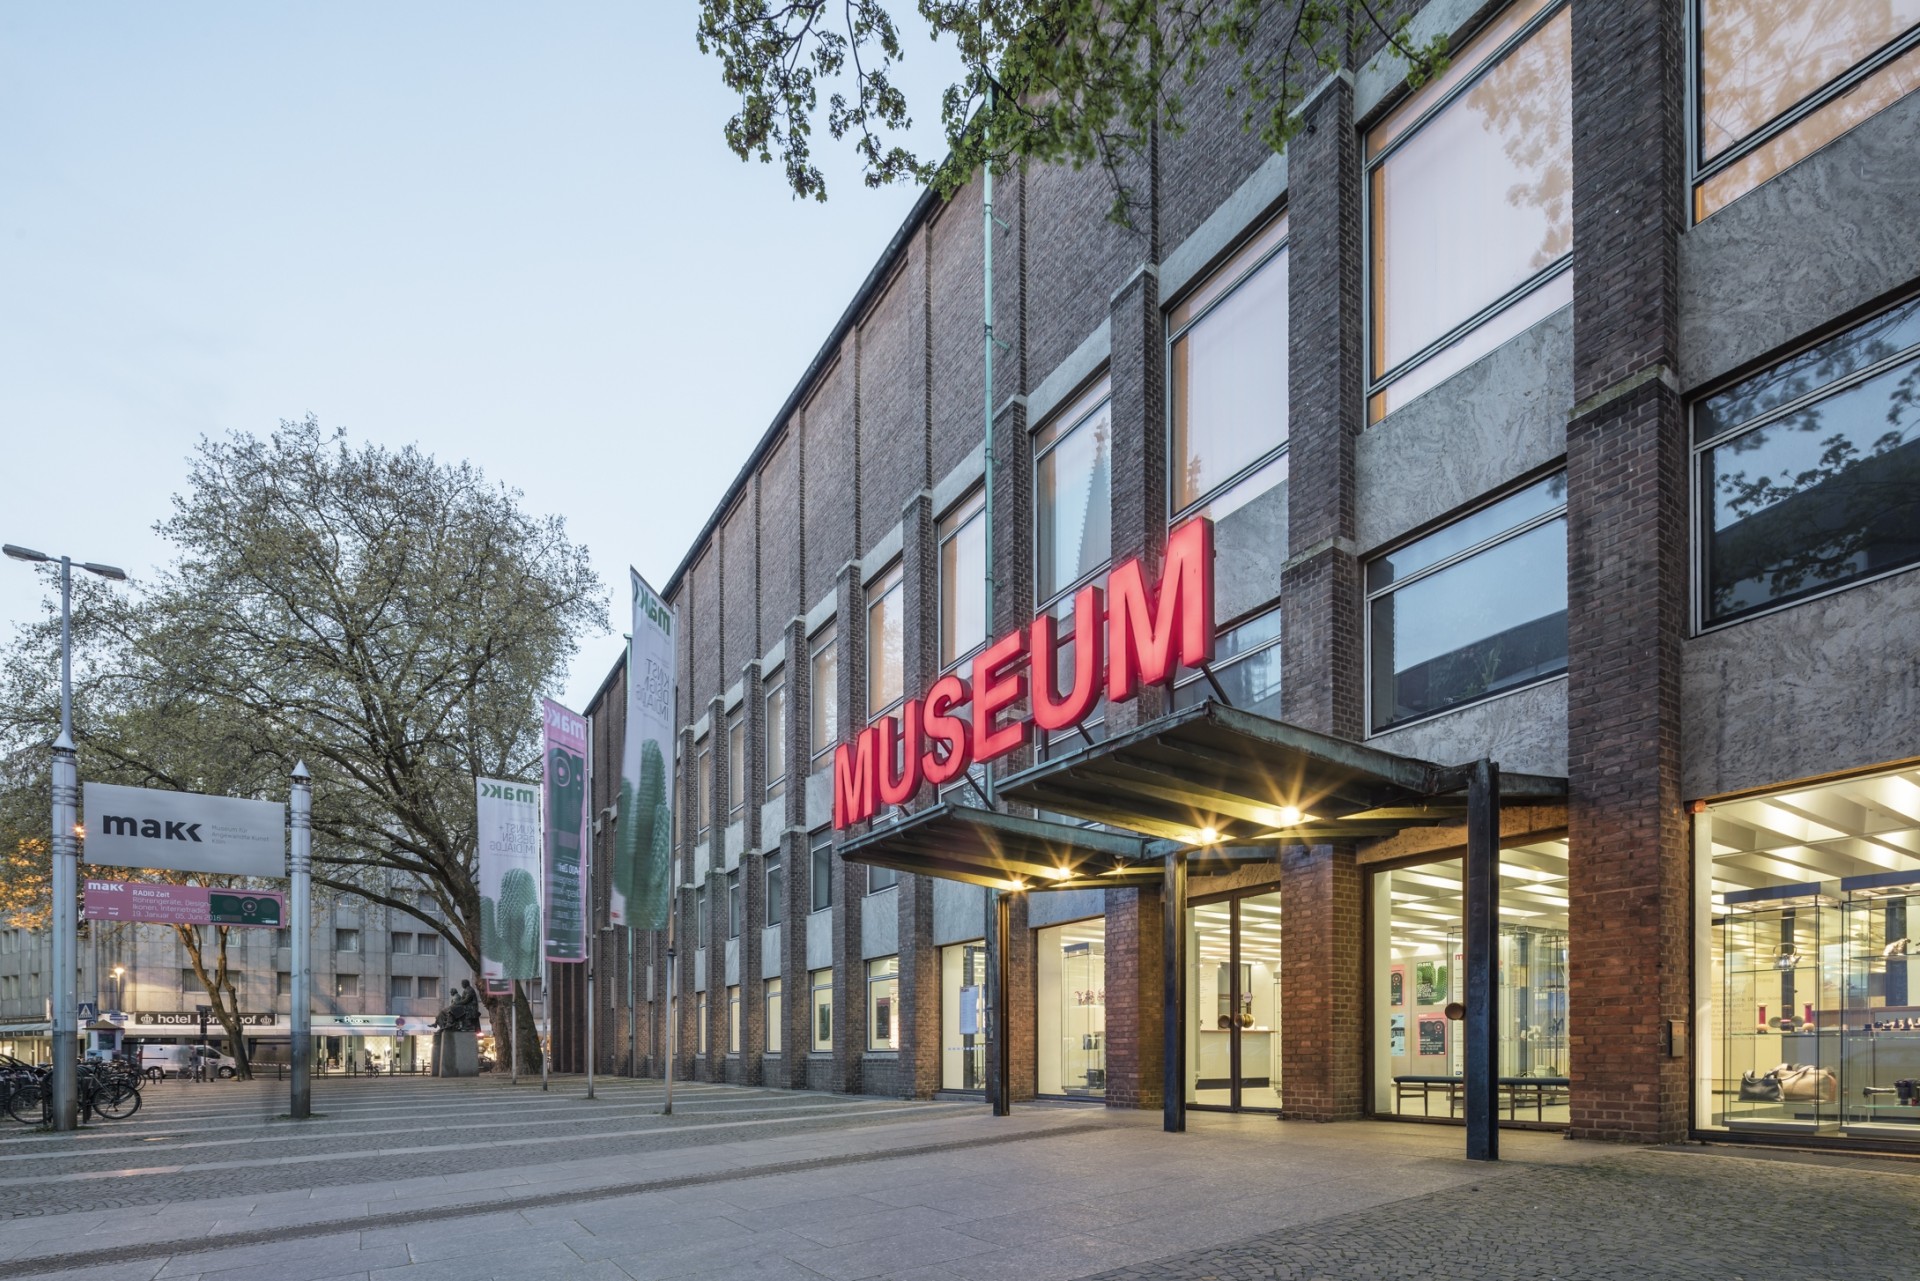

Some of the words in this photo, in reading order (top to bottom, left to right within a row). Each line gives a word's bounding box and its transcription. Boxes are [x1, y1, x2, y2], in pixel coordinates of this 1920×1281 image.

[834, 515, 1215, 830] MUSEUM
[132, 889, 155, 897] RADIO
[157, 1014, 191, 1025] hotel
